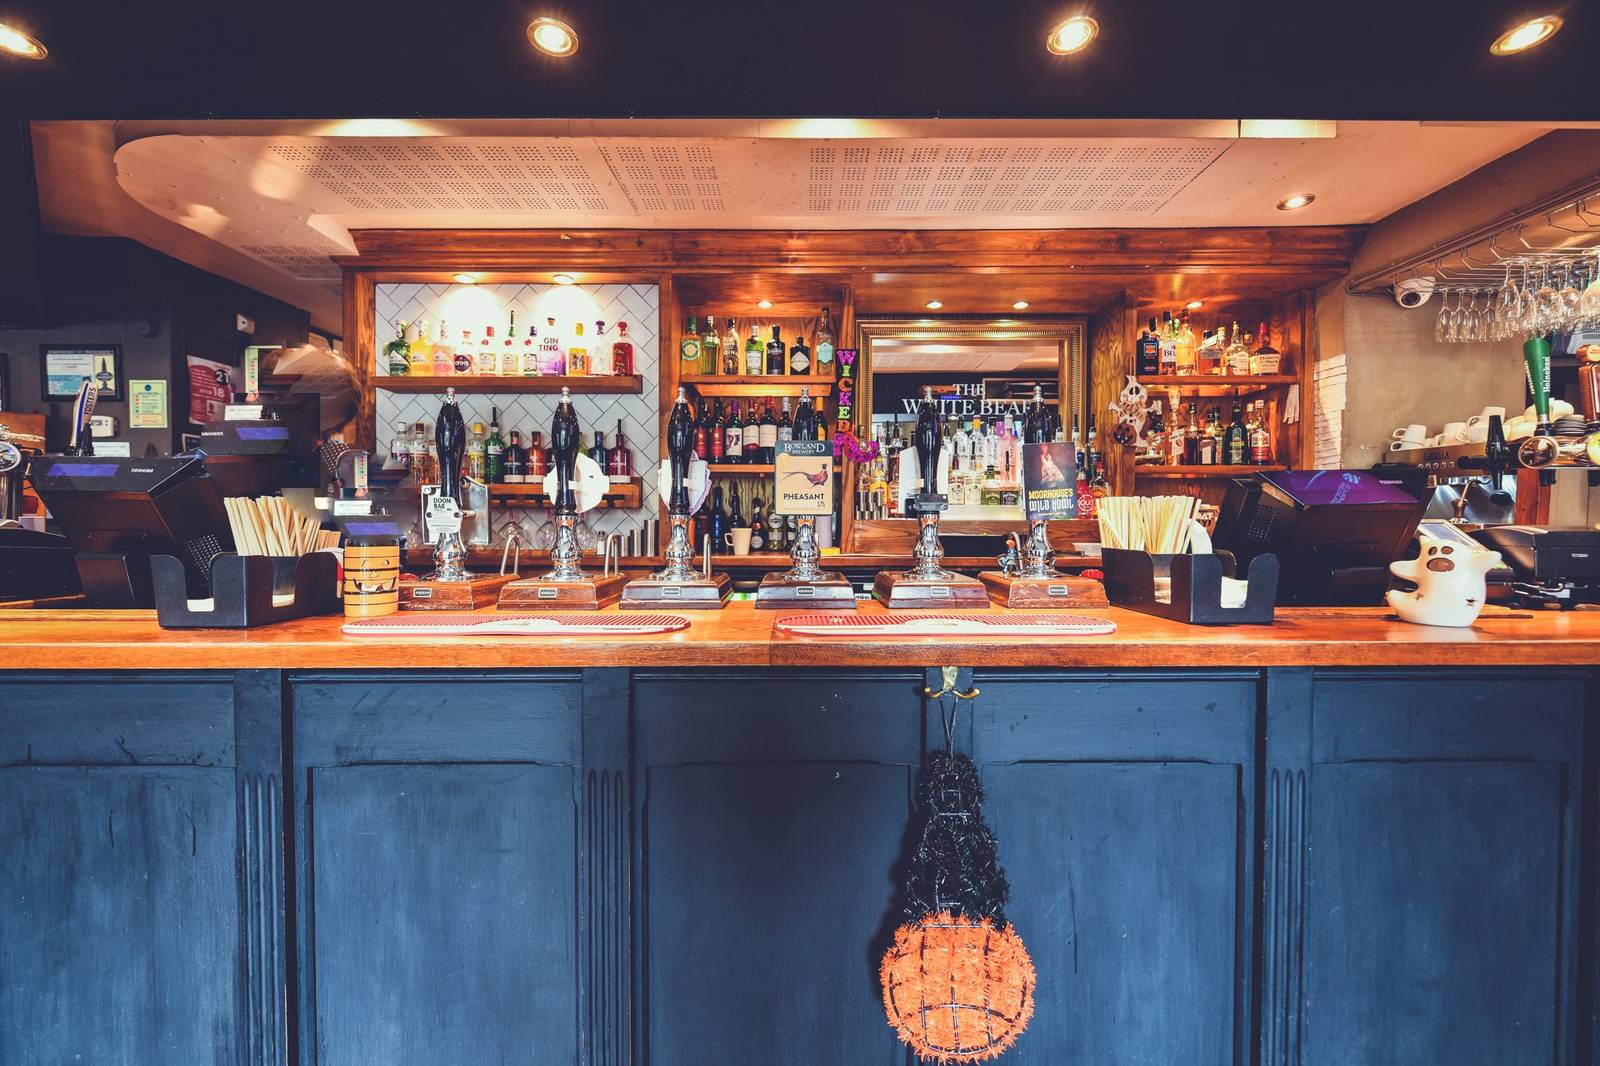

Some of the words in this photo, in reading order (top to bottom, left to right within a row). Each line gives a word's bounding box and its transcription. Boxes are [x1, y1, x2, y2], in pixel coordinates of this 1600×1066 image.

[538, 344, 559, 352] TING
[1542, 356, 1551, 393] Heineken
[211, 386, 225, 398] 18
[952, 383, 986, 396] THE
[784, 442, 826, 453] BOWLAND
